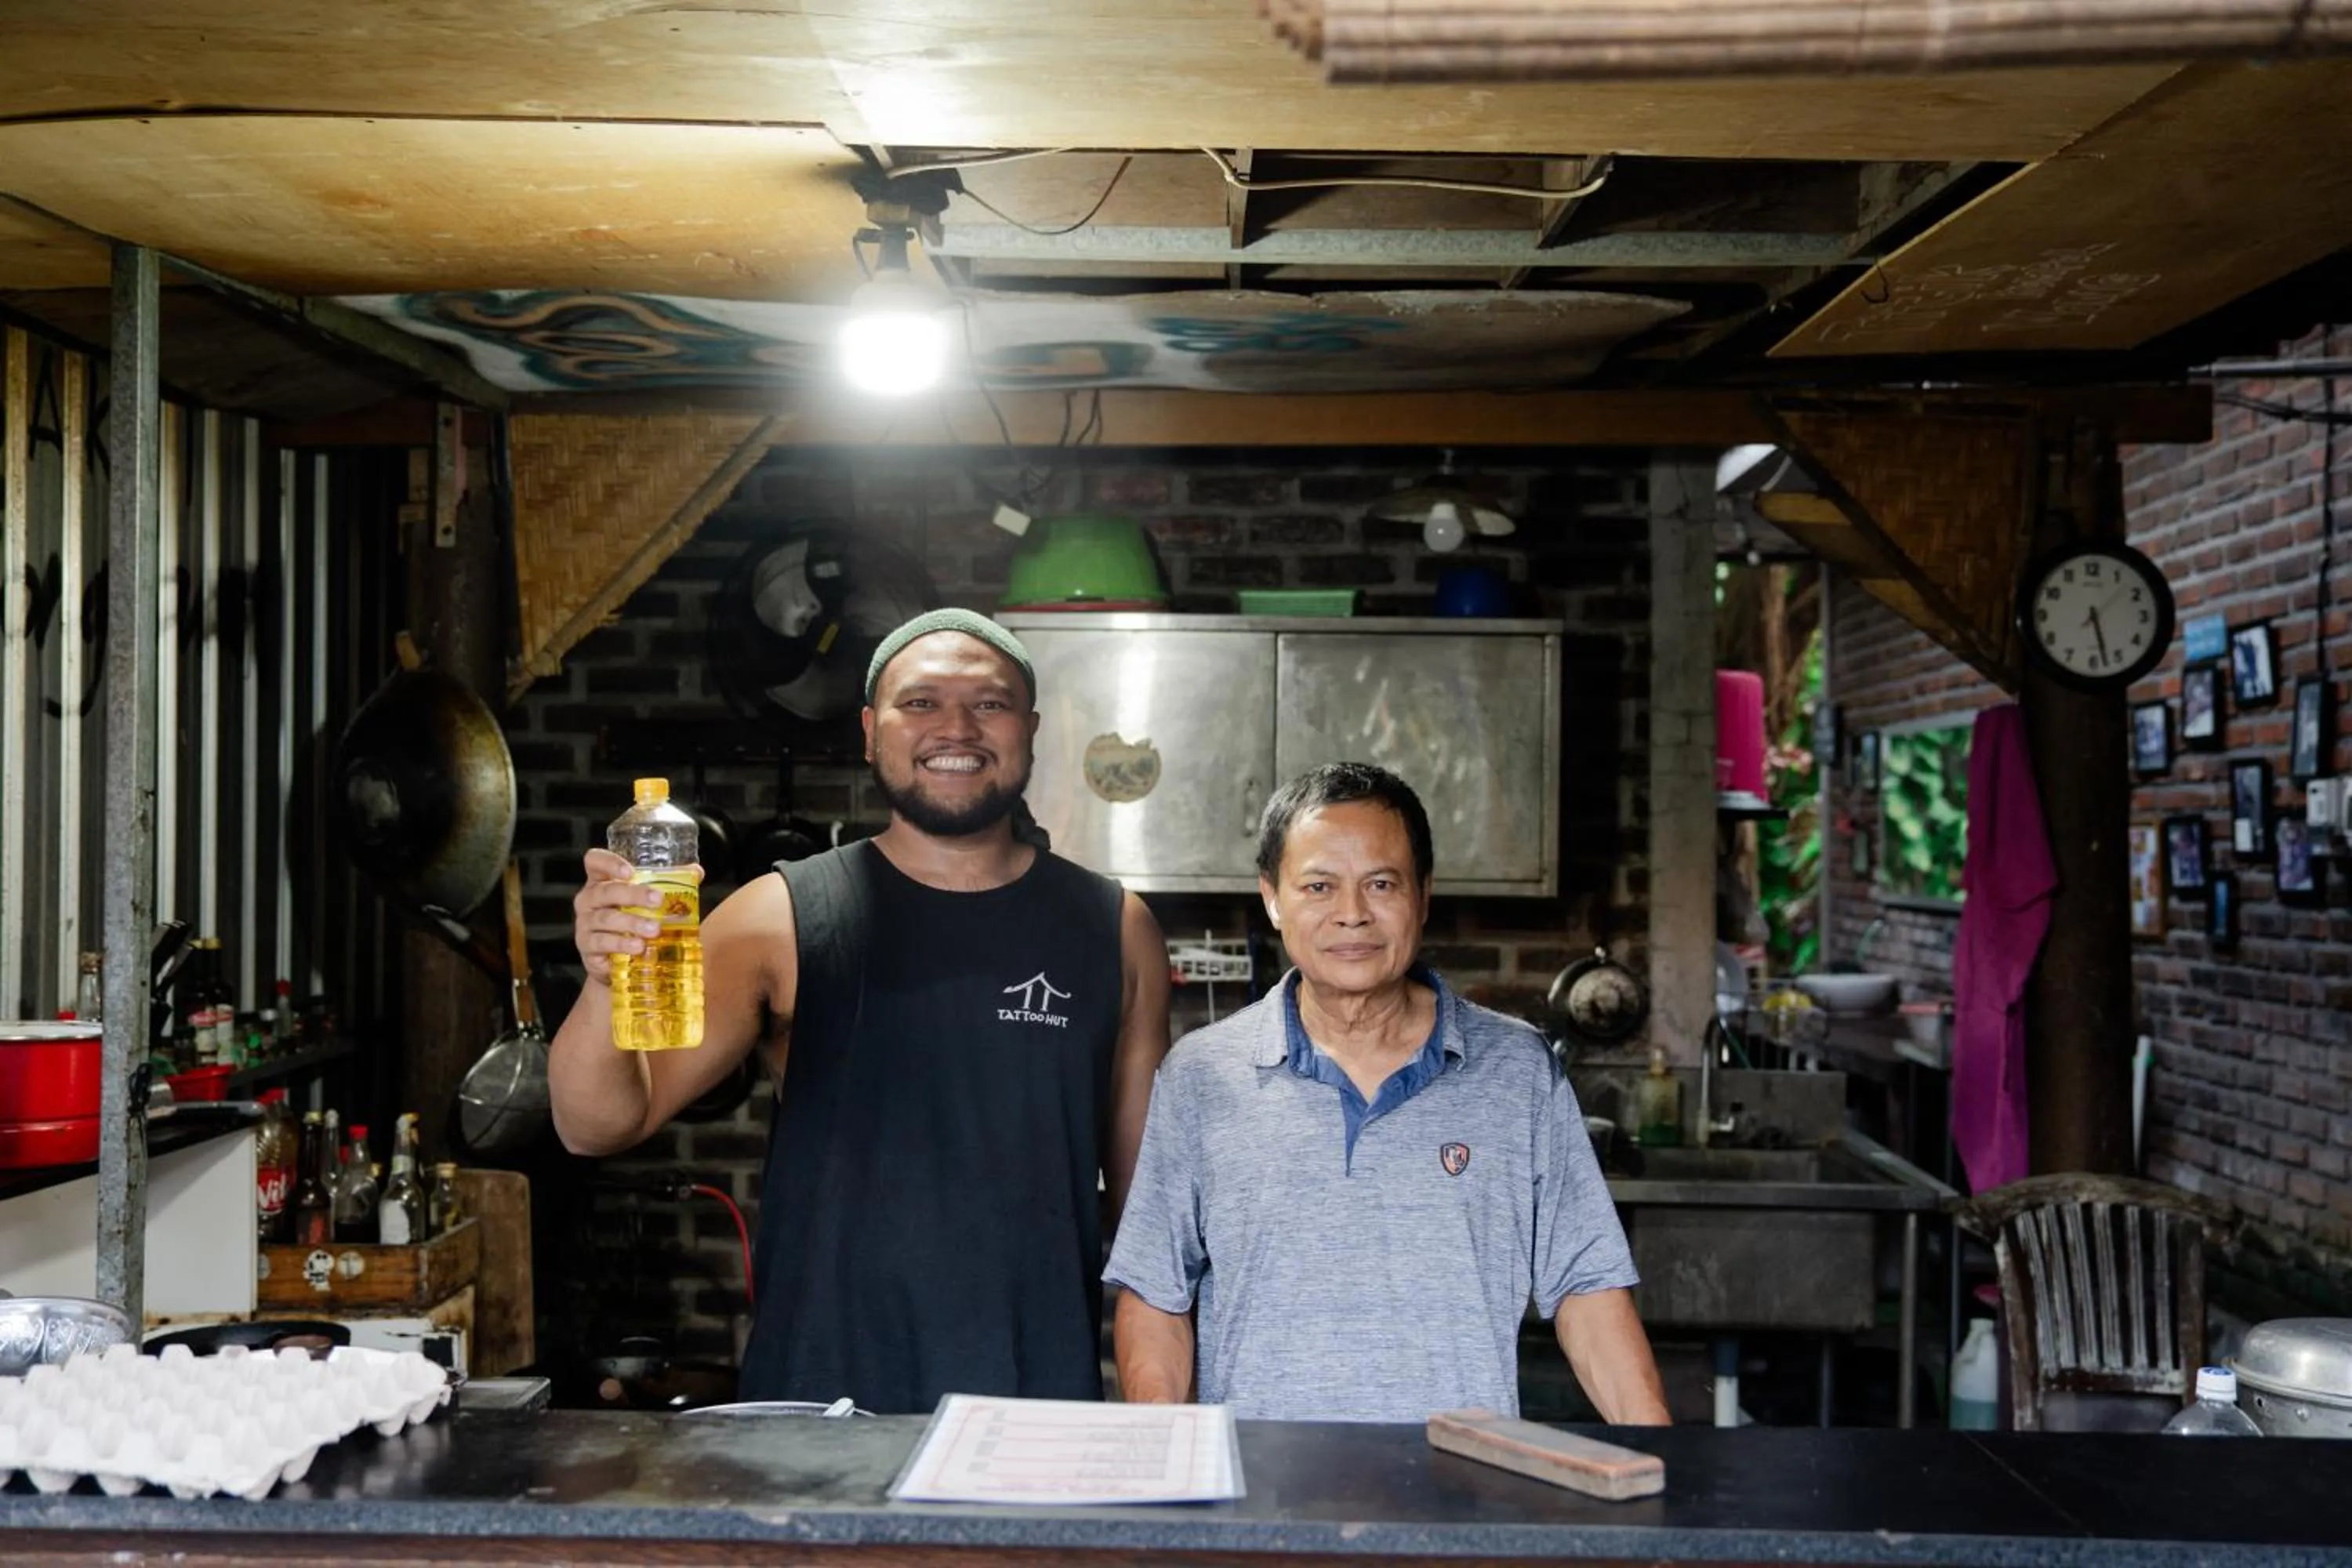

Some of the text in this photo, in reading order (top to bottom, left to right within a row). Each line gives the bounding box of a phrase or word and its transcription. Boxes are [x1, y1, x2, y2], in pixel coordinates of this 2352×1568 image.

[2063, 568, 2074, 583] 11
[2084, 562, 2100, 577] 12
[2114, 569, 2121, 583] 1
[2045, 586, 2061, 601] 10
[2131, 587, 2141, 602] 2
[2038, 608, 2048, 622] 9
[2139, 609, 2149, 624] 3
[2045, 631, 2056, 646] 8
[2131, 633, 2141, 647] 4
[2064, 648, 2074, 662] 7
[2088, 655, 2099, 670] 6
[2114, 649, 2123, 663] 5
